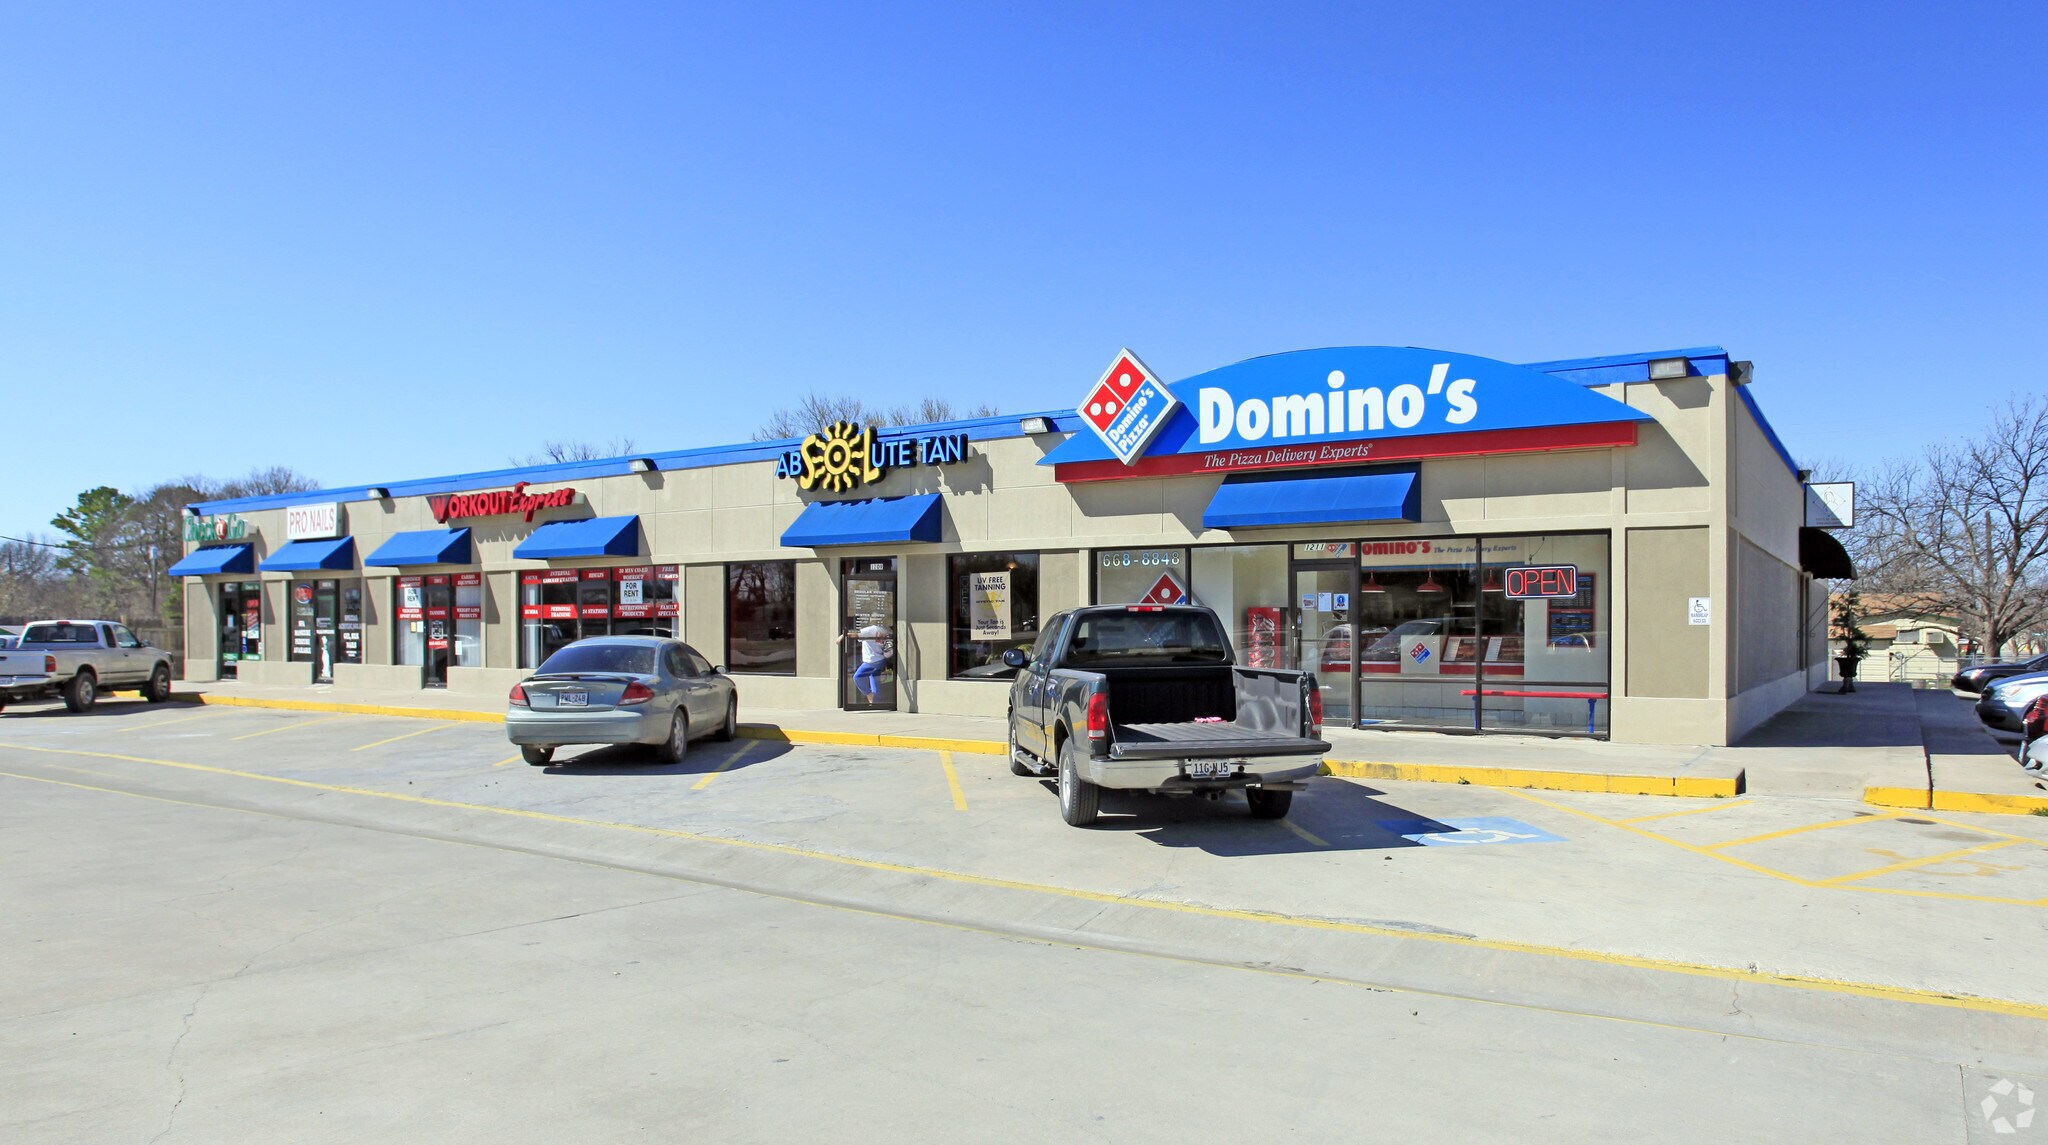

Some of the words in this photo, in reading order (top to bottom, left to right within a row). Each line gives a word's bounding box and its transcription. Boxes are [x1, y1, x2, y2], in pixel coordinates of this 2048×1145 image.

[1108, 388, 1155, 442] Domino's
[1200, 363, 1478, 444] Domino's
[918, 436, 964, 465] TAN
[1204, 454, 1226, 468] The
[1229, 452, 1262, 466] Pizza
[1265, 448, 1318, 464] Delivery
[431, 491, 508, 524] WORKOUT
[509, 481, 576, 523] Express
[226, 513, 245, 540] Go
[289, 511, 308, 534] PRO
[309, 508, 335, 532] NAILS
[1103, 551, 1180, 567] 668-8848
[1305, 543, 1325, 551] 1211
[623, 589, 639, 597] RENT
[974, 583, 1006, 591] TANNING
[1508, 569, 1574, 596] OPEN
